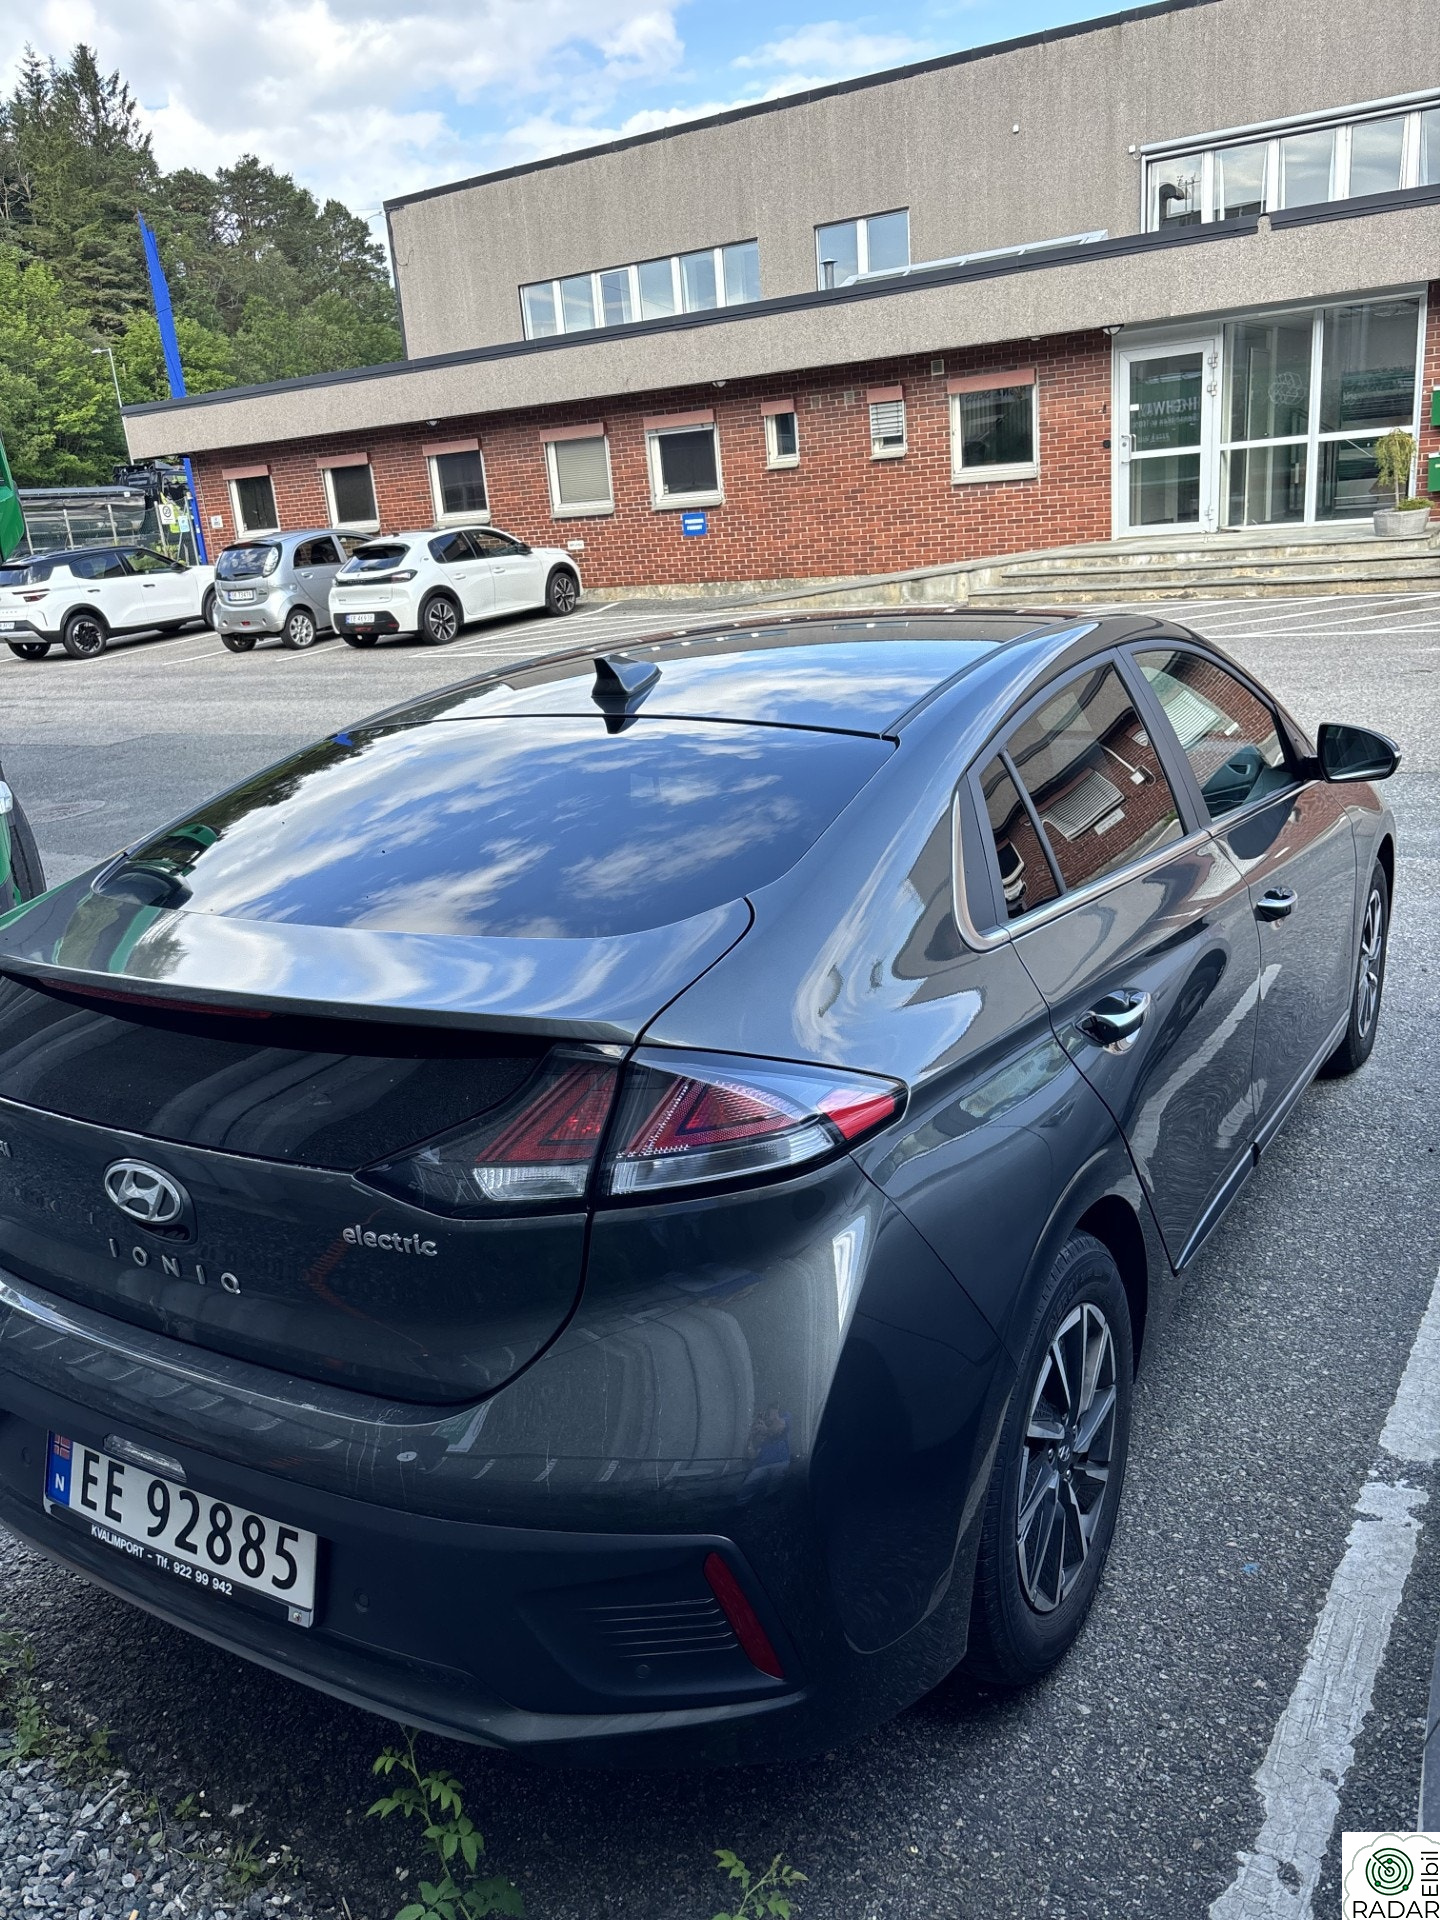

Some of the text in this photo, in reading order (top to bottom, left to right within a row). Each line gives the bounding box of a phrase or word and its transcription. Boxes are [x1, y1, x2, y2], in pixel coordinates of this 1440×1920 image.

[109, 1238, 241, 1294] IONIQ
[342, 1224, 438, 1257] electric
[54, 1472, 65, 1492] N
[81, 1449, 299, 1590] EE 92885
[91, 1523, 145, 1559] KVALIMPORT
[155, 1553, 170, 1570] Tlf.
[173, 1561, 193, 1580] 922
[195, 1570, 209, 1586] 99
[212, 1577, 233, 1596] 942
